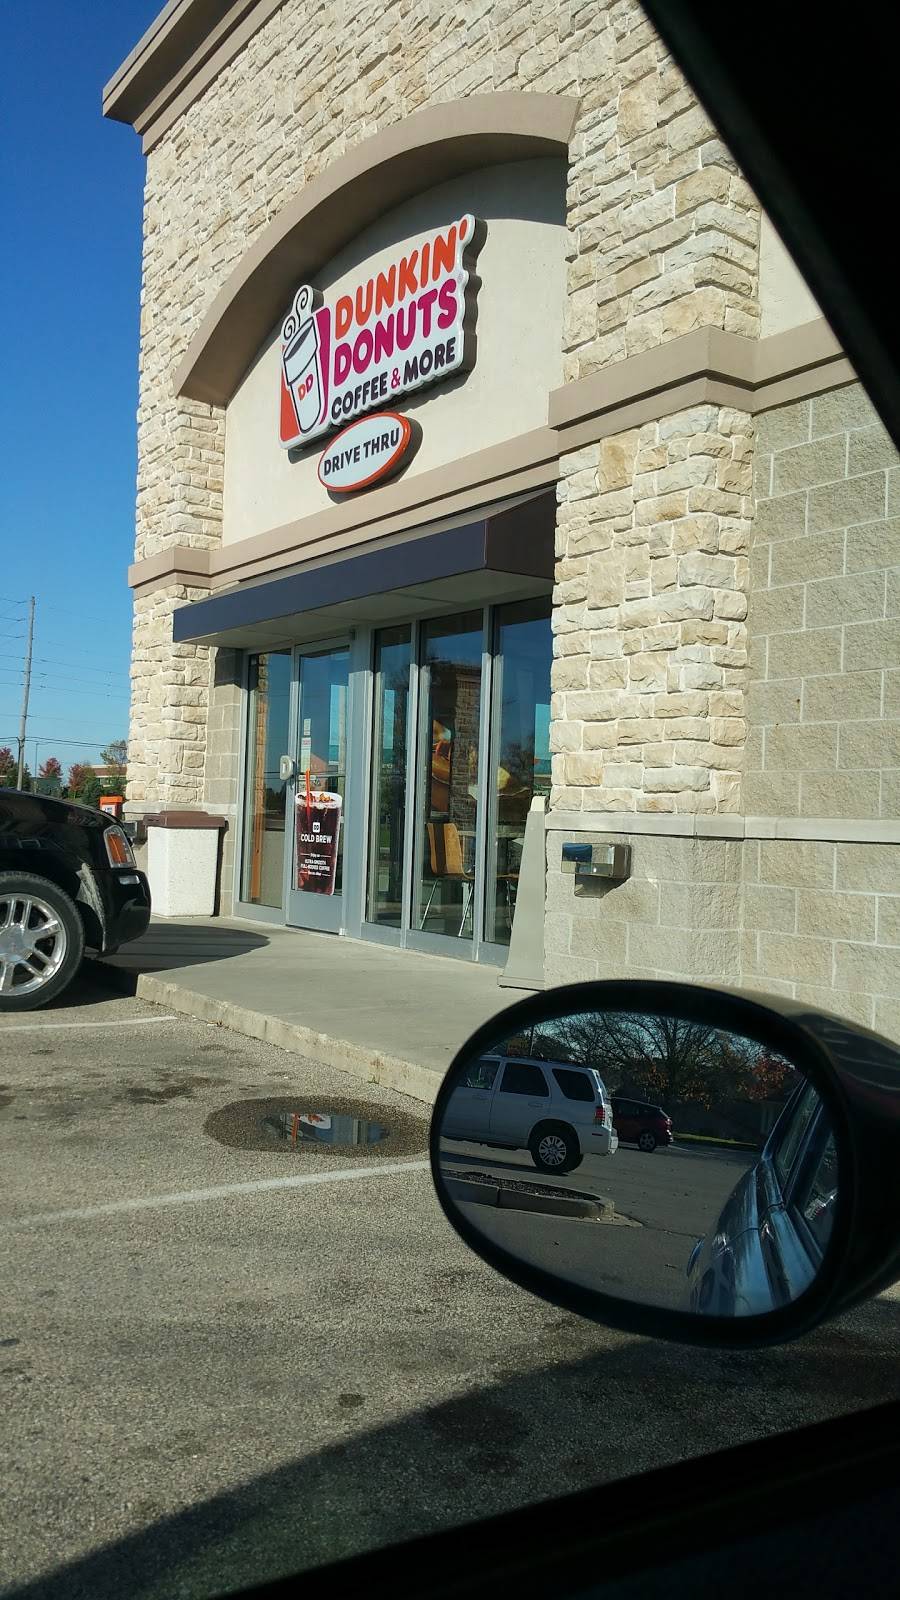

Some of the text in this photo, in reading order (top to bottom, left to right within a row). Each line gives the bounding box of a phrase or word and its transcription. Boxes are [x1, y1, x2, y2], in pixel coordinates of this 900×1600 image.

[335, 218, 468, 340] DUNKIN'
[334, 278, 457, 386] DONUTS
[297, 374, 313, 401] DD
[331, 337, 456, 420] COFFEE & MORE
[323, 427, 400, 476] DRIVE THRU
[300, 833, 333, 844] COLD BREW
